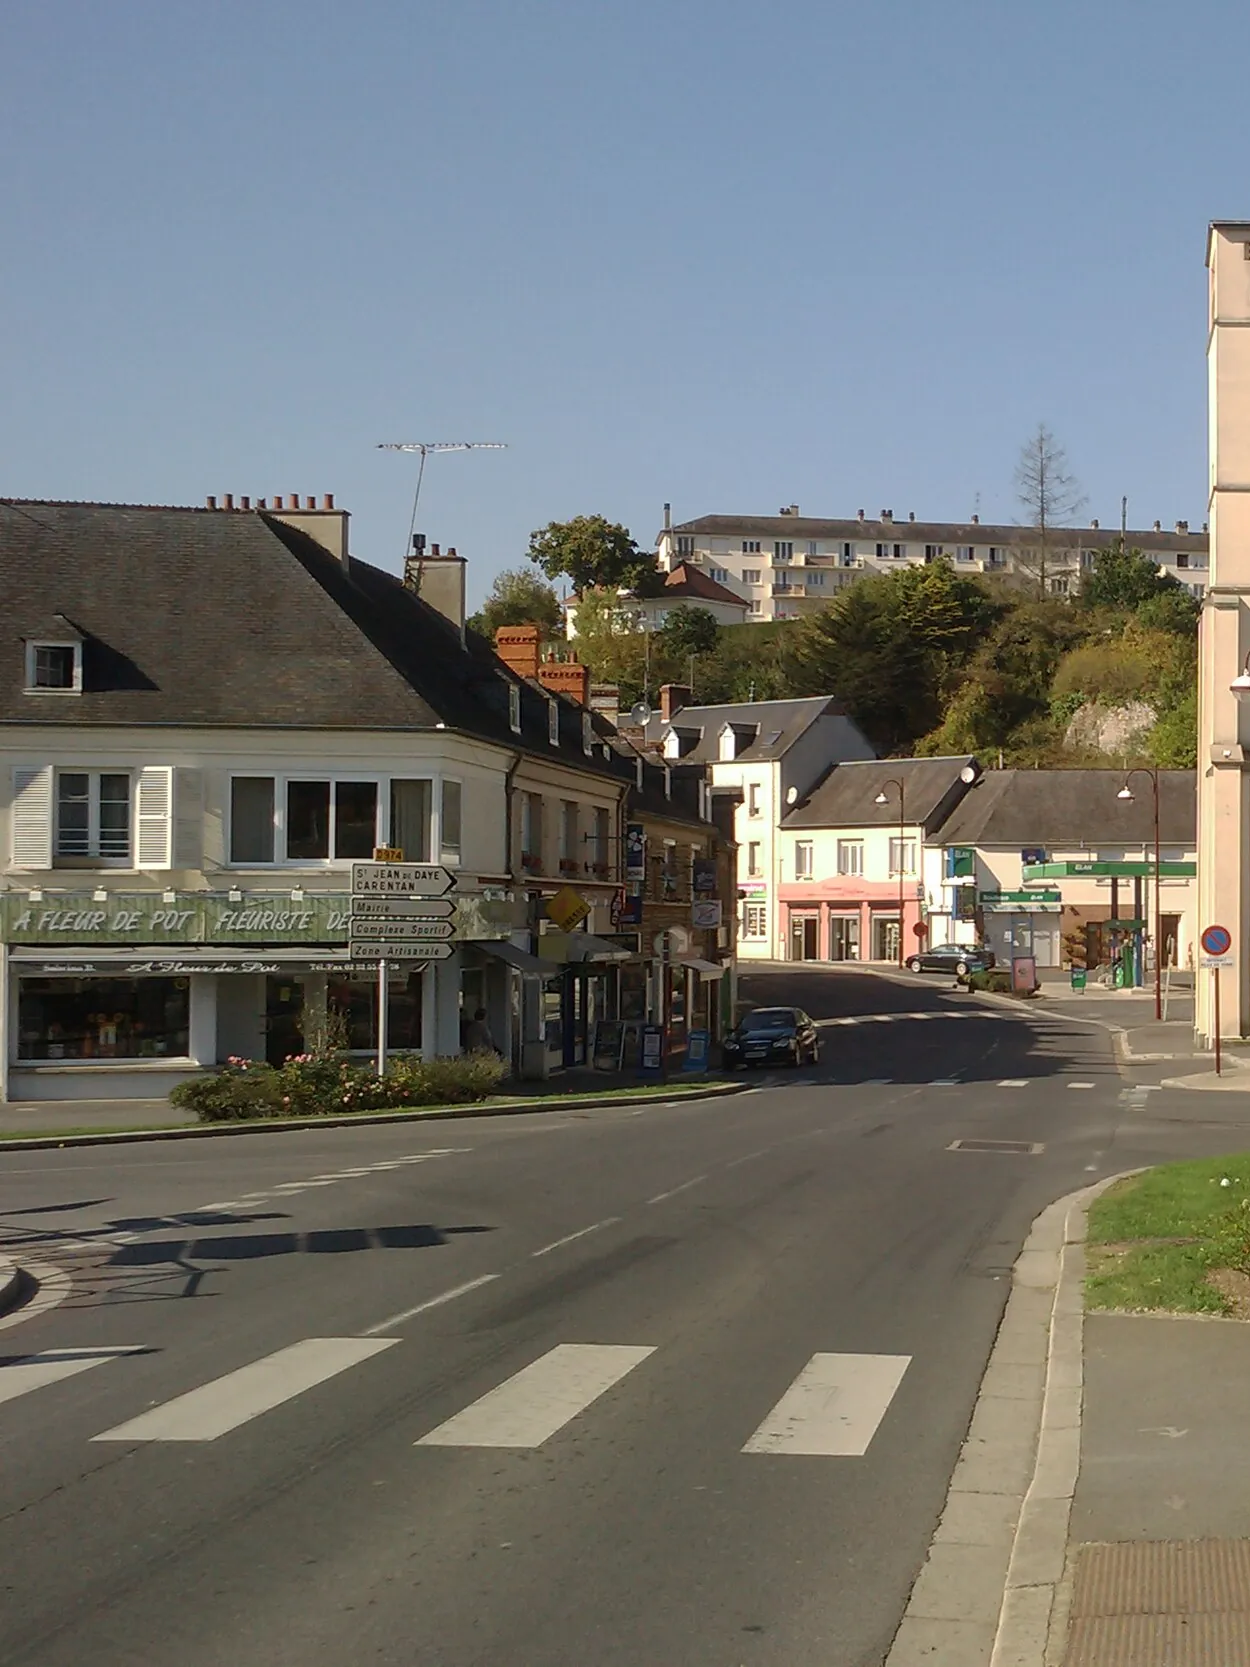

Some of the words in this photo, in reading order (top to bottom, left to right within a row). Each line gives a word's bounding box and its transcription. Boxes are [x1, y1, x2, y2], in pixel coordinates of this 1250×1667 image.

[374, 870, 399, 879] JEAN
[414, 871, 440, 880] DAYE
[356, 882, 415, 891] CARENTAN
[356, 902, 390, 912] Mairie
[13, 910, 32, 931] A
[38, 910, 106, 932] FLEUR
[112, 910, 143, 932] DE
[150, 910, 196, 932] POT
[214, 910, 314, 932] FLEURISTE
[356, 924, 404, 934] Complexe
[411, 925, 446, 935] Sportif
[356, 946, 380, 955] Zone
[388, 946, 439, 956] Artisanale
